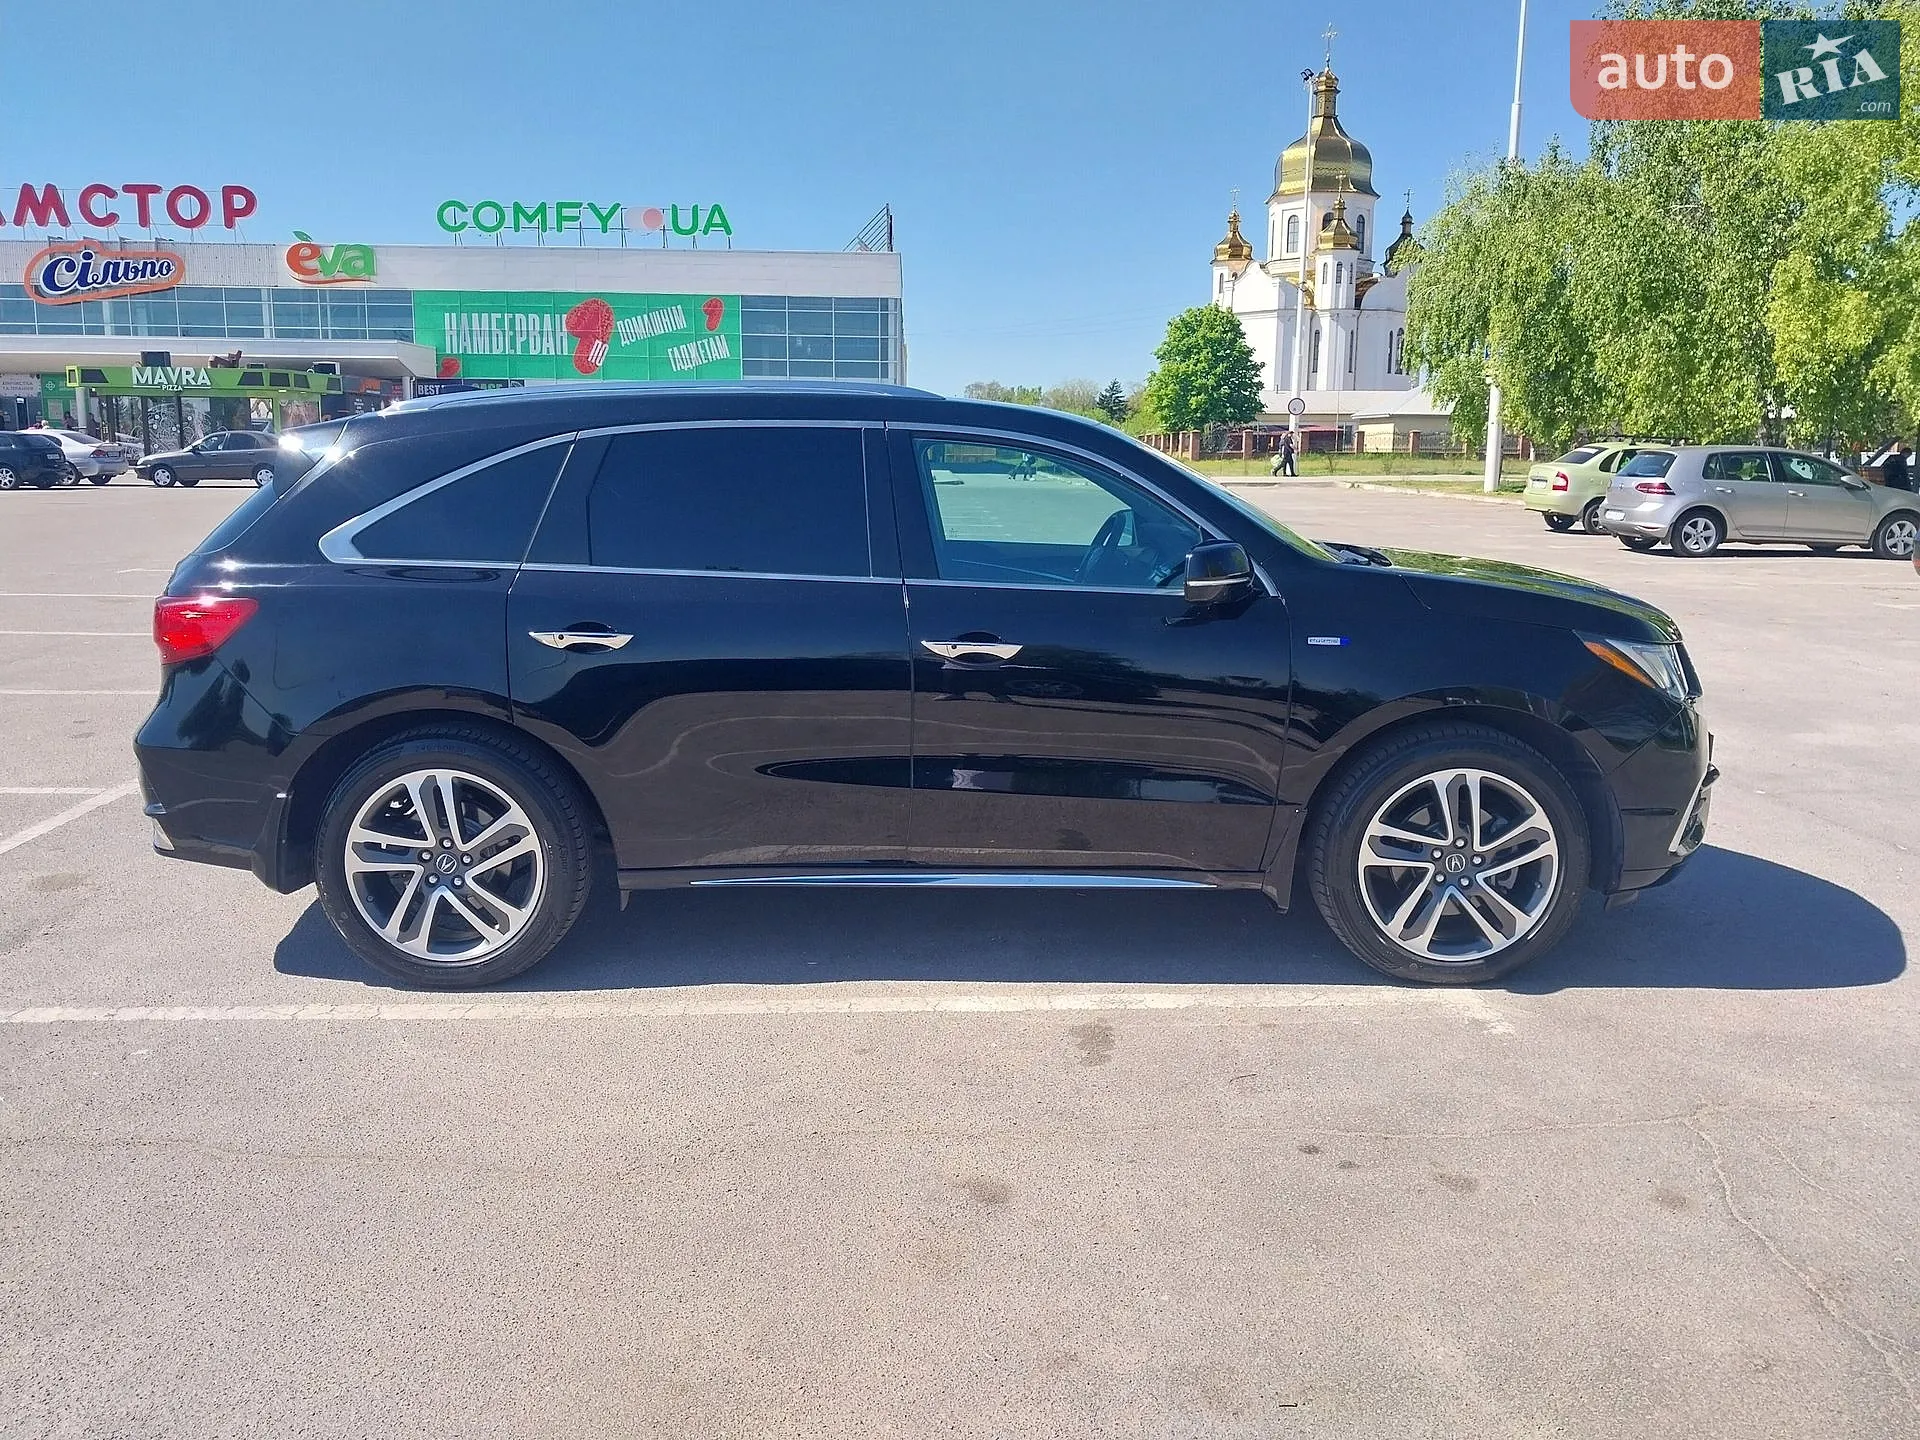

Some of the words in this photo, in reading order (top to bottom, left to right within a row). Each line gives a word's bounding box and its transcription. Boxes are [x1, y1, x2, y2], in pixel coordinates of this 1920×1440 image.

[0, 183, 258, 230] МСТОР
[436, 199, 622, 235] COMFY
[40, 249, 176, 294] Сільпо
[444, 312, 569, 356] НАМБЕРВАН
[616, 304, 687, 348] ДОМАШНІМ
[587, 338, 609, 367] ПО
[667, 334, 731, 373] ГАДЖЕТАМ
[132, 366, 211, 386] MAVRA
[417, 384, 440, 395] BEST
